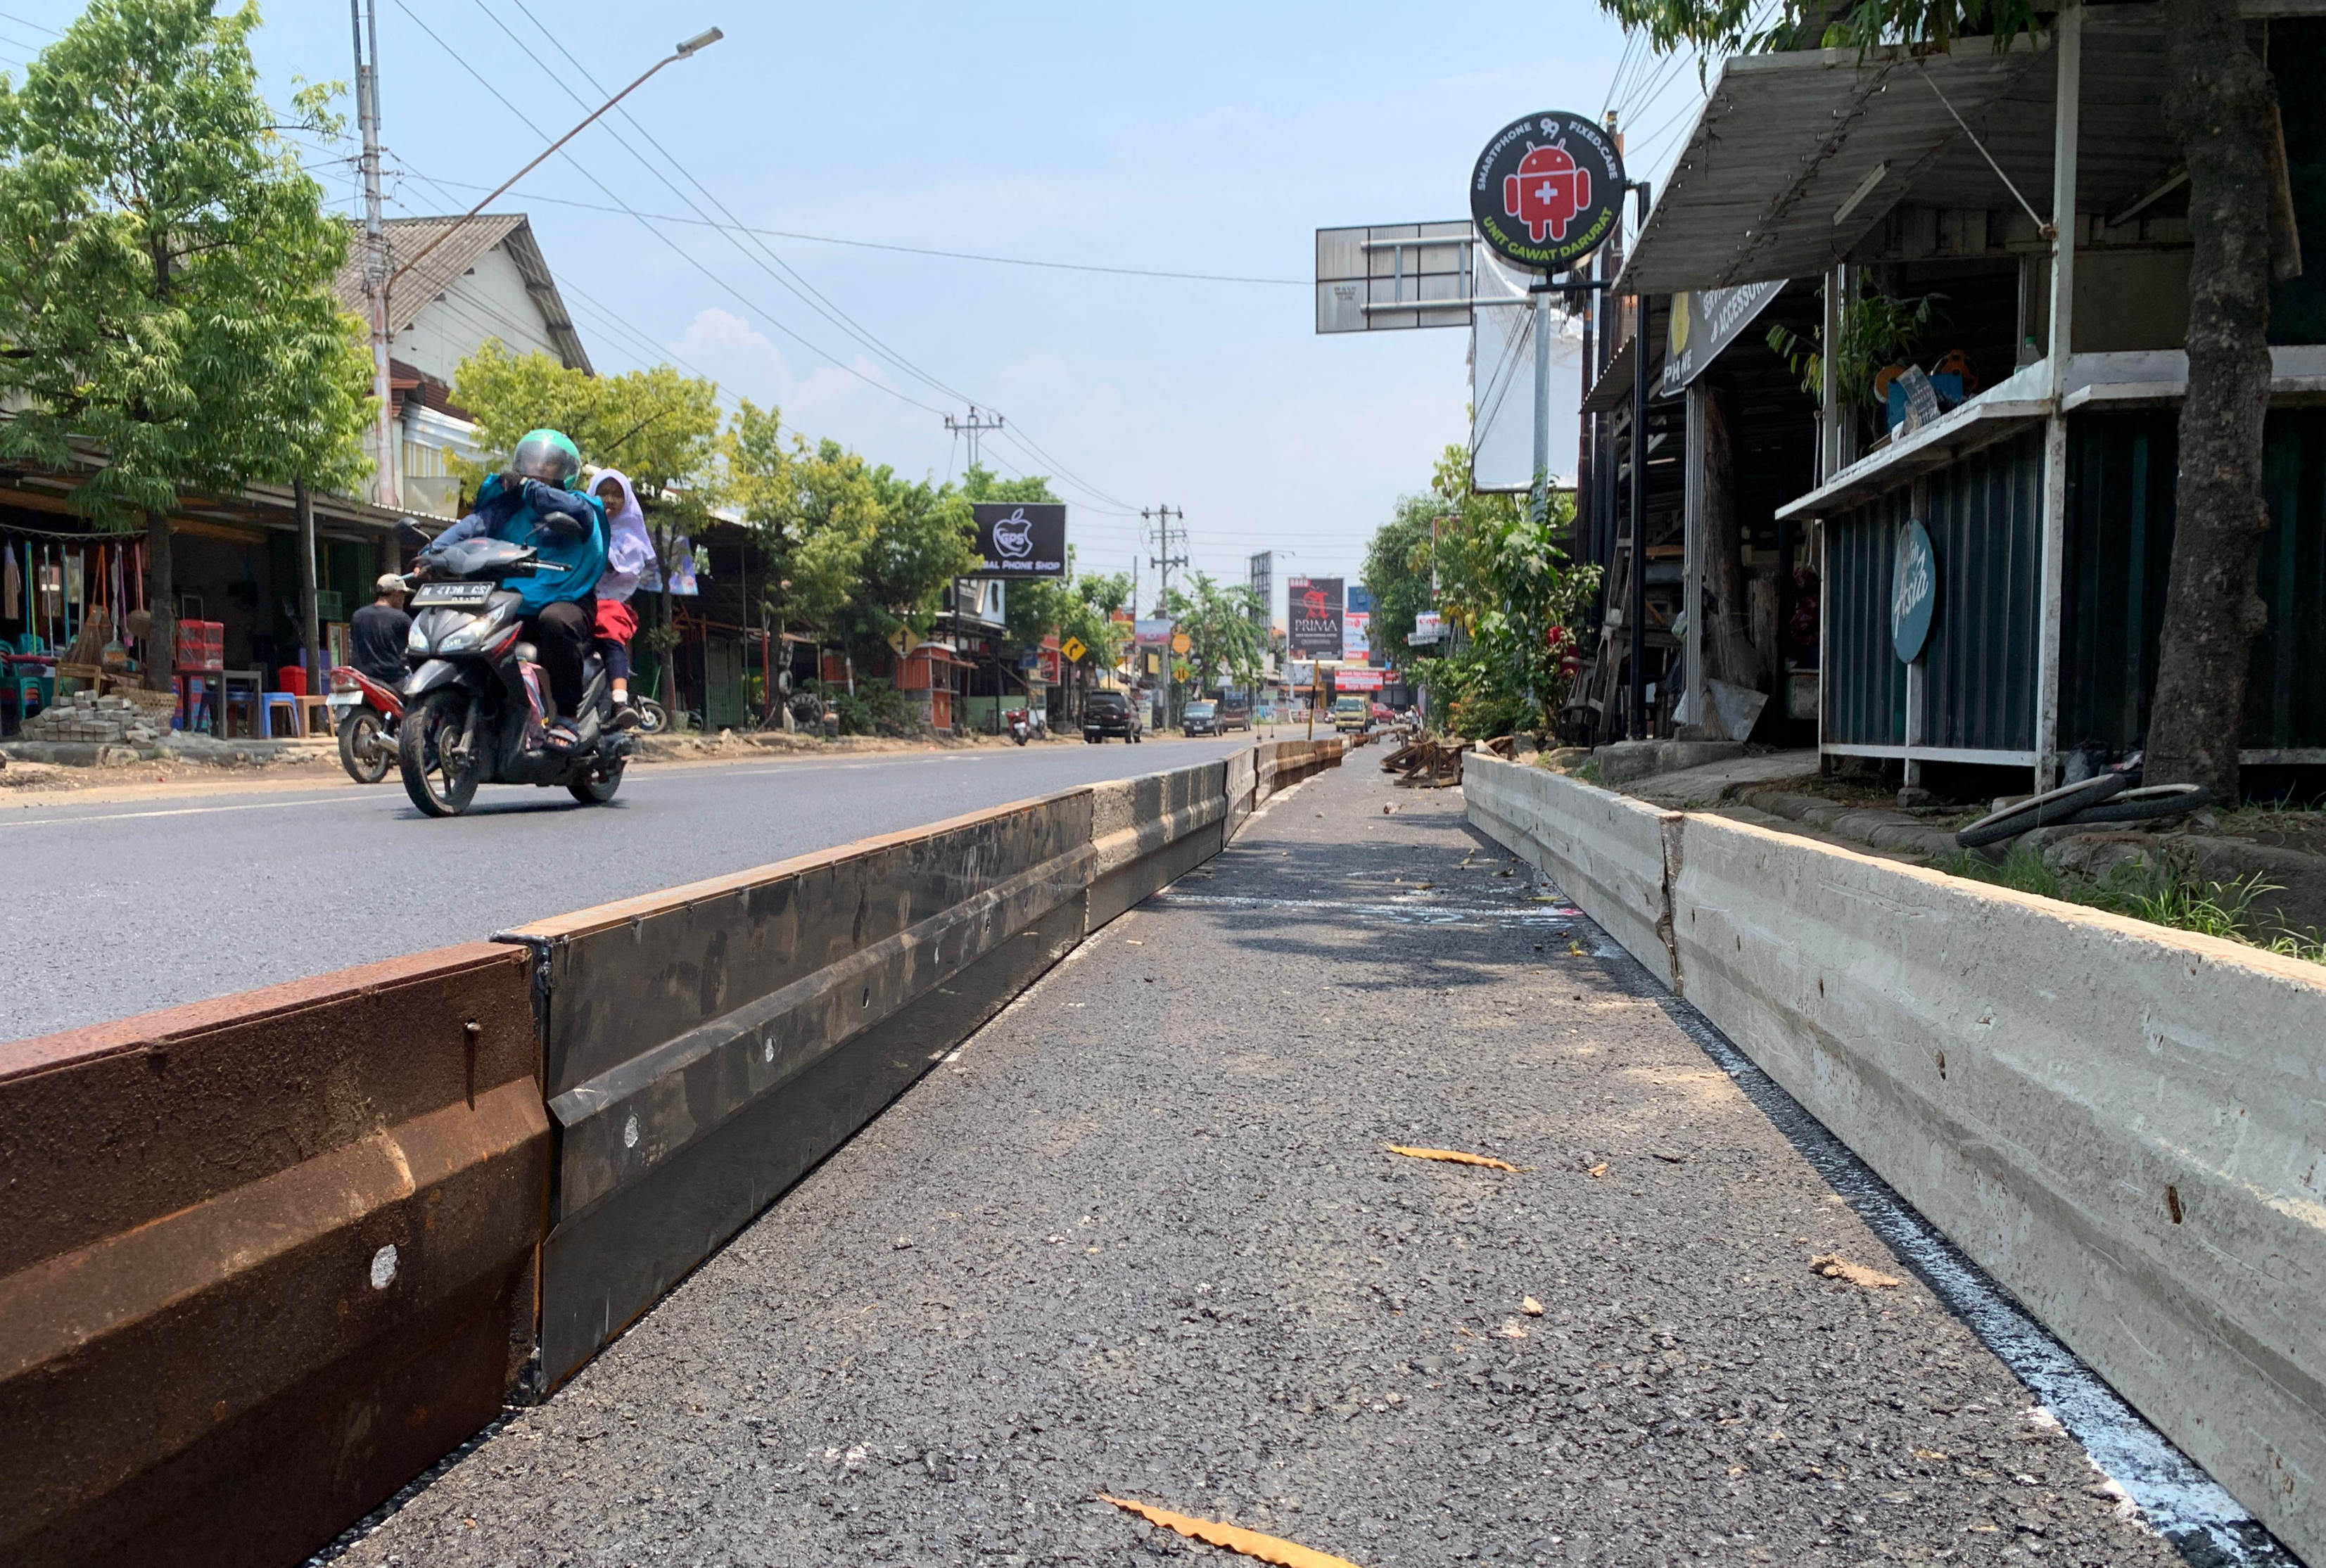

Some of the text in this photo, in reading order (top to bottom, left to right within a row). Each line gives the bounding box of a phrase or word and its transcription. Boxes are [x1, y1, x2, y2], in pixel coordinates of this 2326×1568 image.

[1477, 121, 1532, 191] SMARTPHONE
[1568, 120, 1618, 180] FIXED.CARE
[1482, 206, 1613, 261] UNIT GAWAT DARURAT
[1002, 560, 1034, 570] PHONE
[1035, 561, 1061, 571] SHOP
[1295, 619, 1337, 632] PRIMA
